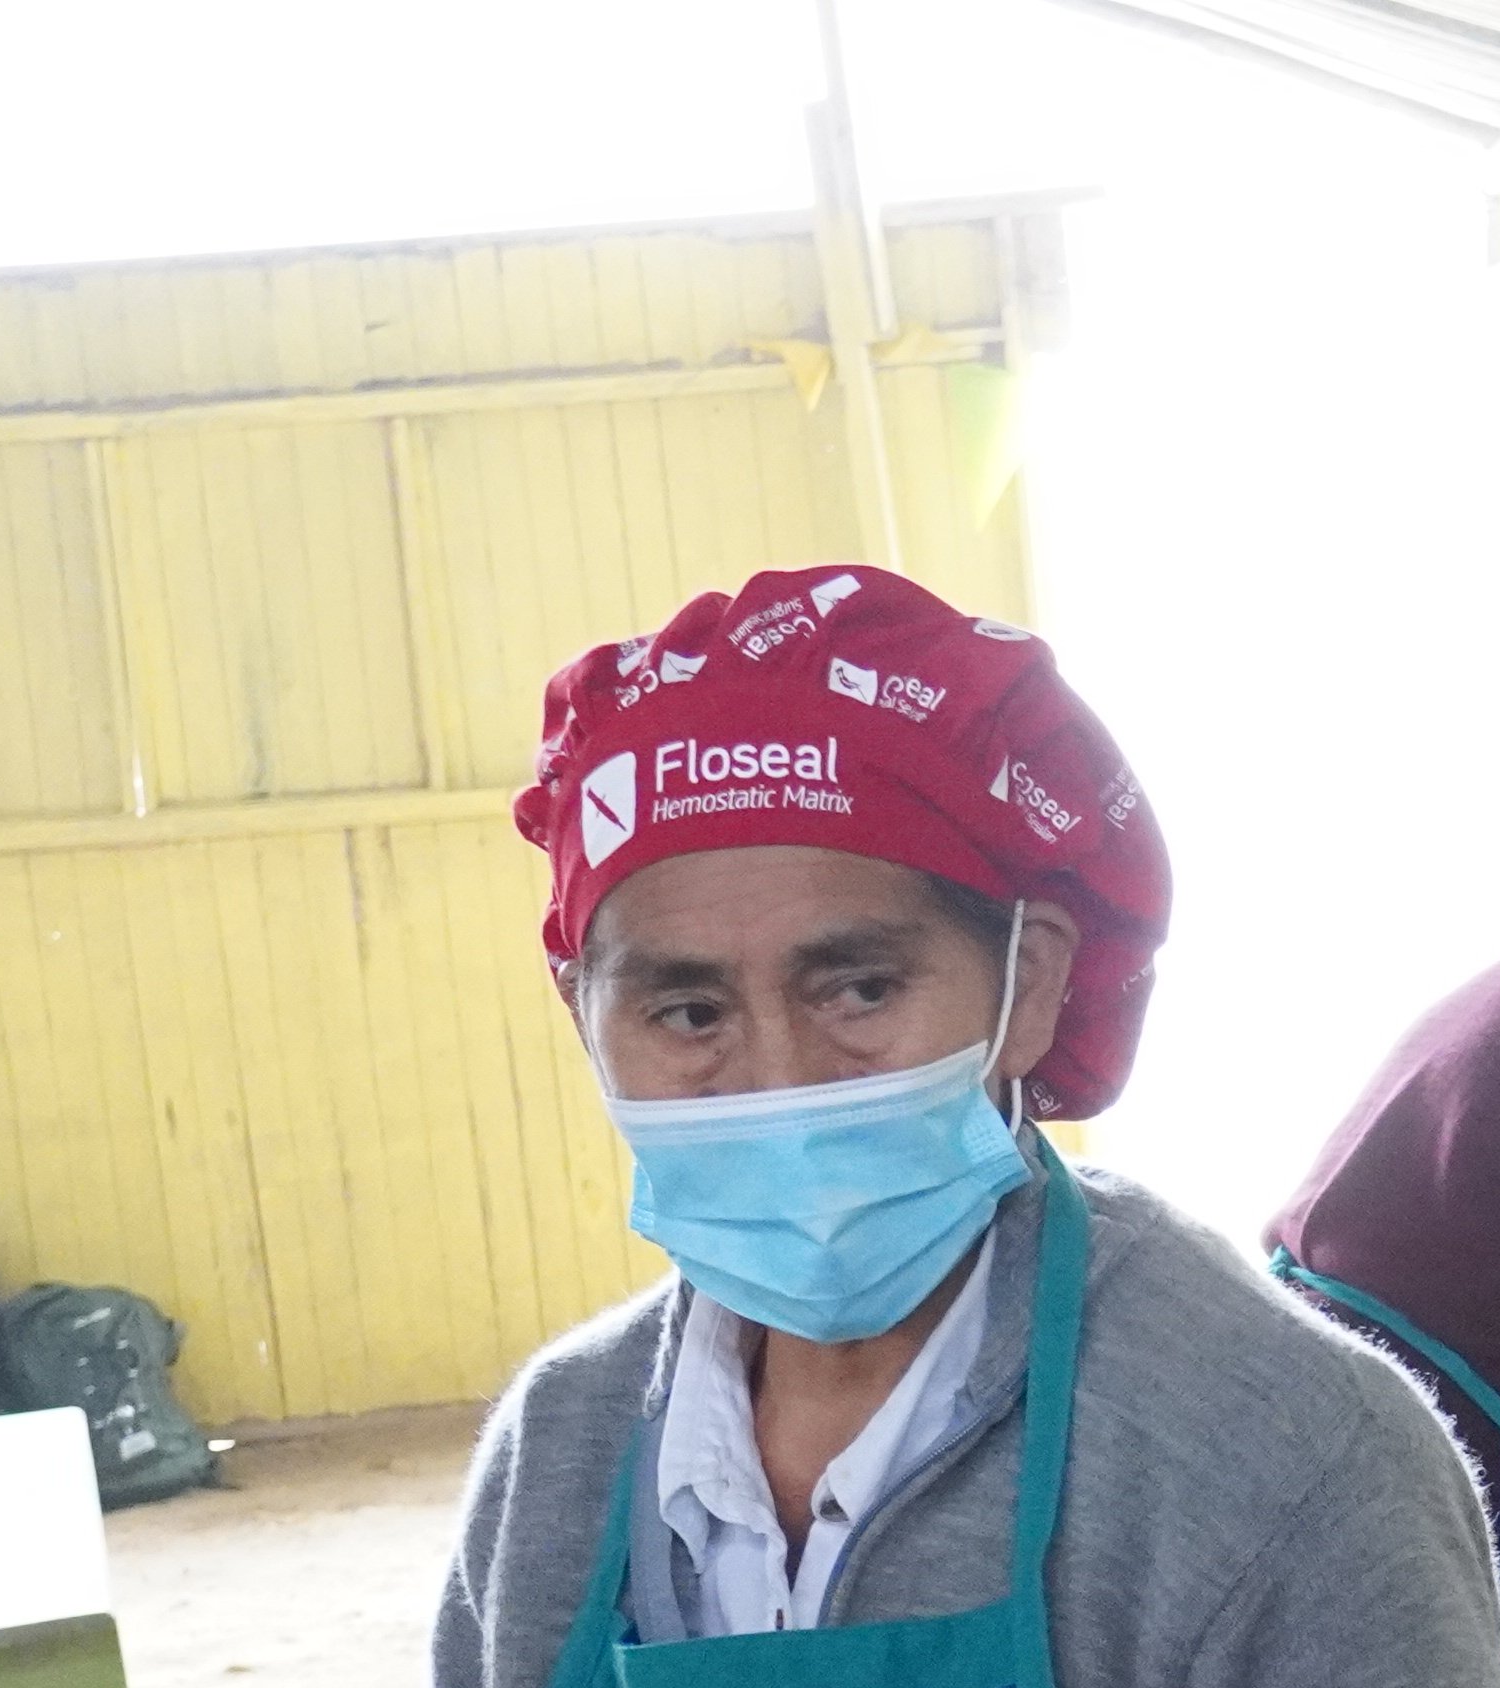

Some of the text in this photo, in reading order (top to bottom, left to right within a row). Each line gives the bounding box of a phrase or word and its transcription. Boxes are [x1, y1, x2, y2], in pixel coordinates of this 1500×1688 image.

[655, 736, 839, 793] Floseal
[652, 783, 854, 824] Hemostatic Matrix
